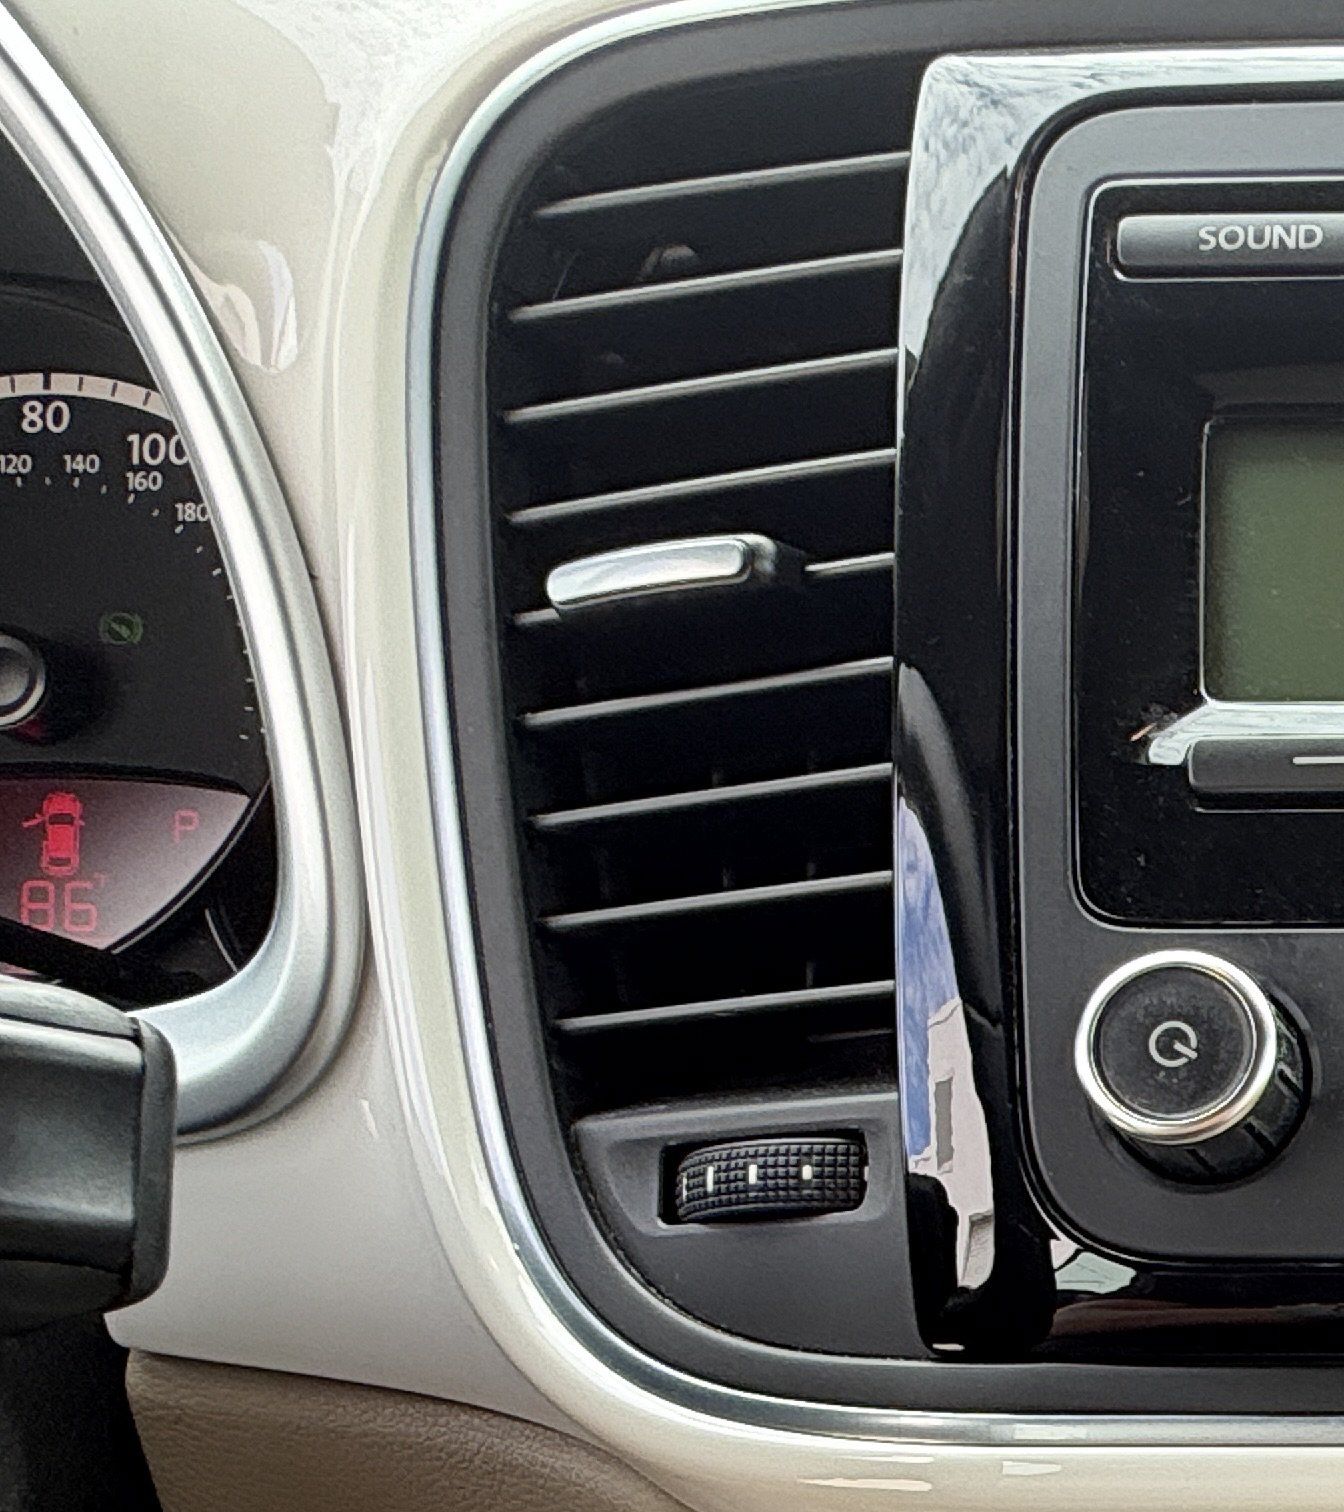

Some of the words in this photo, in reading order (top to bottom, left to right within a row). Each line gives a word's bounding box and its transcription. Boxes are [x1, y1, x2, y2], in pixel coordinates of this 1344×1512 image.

[1198, 224, 1324, 251] SOUND
[21, 400, 71, 434] 80
[126, 433, 190, 466] 100
[0, 454, 33, 474] 120
[62, 454, 100, 474] 140
[125, 470, 163, 491] 160
[174, 502, 211, 522] 180
